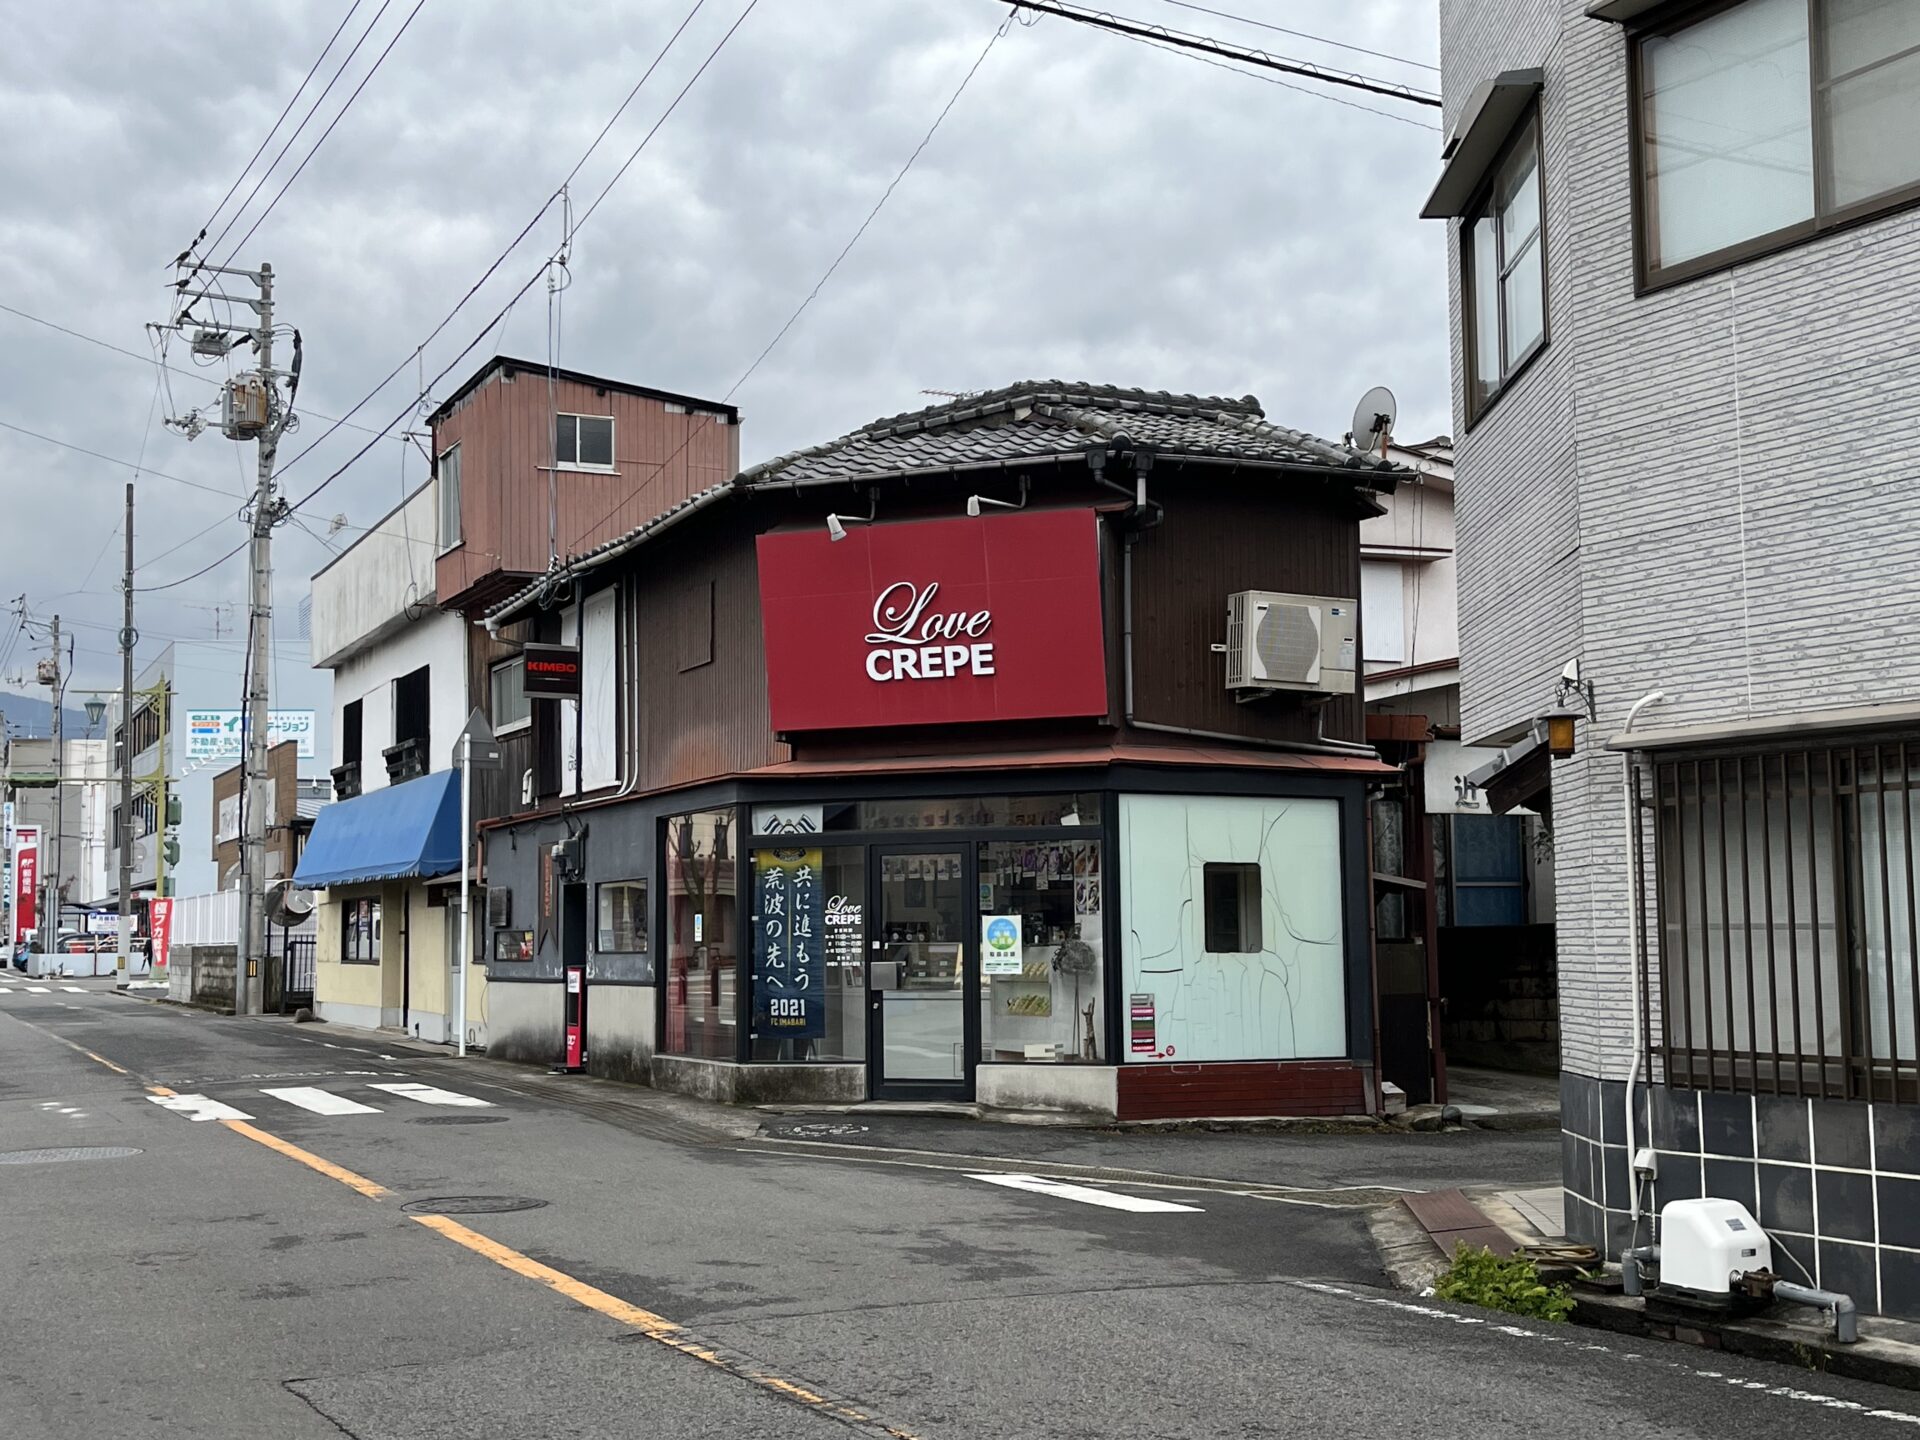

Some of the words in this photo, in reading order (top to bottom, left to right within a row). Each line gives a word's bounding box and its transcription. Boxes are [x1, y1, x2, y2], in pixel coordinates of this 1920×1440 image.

[864, 582, 991, 645] Love
[527, 661, 577, 673] KIMBO
[865, 643, 995, 682] CREPE
[824, 895, 862, 914] Love
[763, 866, 785, 989] 荒波の先へ
[793, 865, 813, 991] 共に進もう
[824, 914, 862, 925] CREPE
[770, 999, 805, 1016] 2021
[771, 1018, 779, 1026] FC
[780, 1018, 806, 1026] IMABARI
